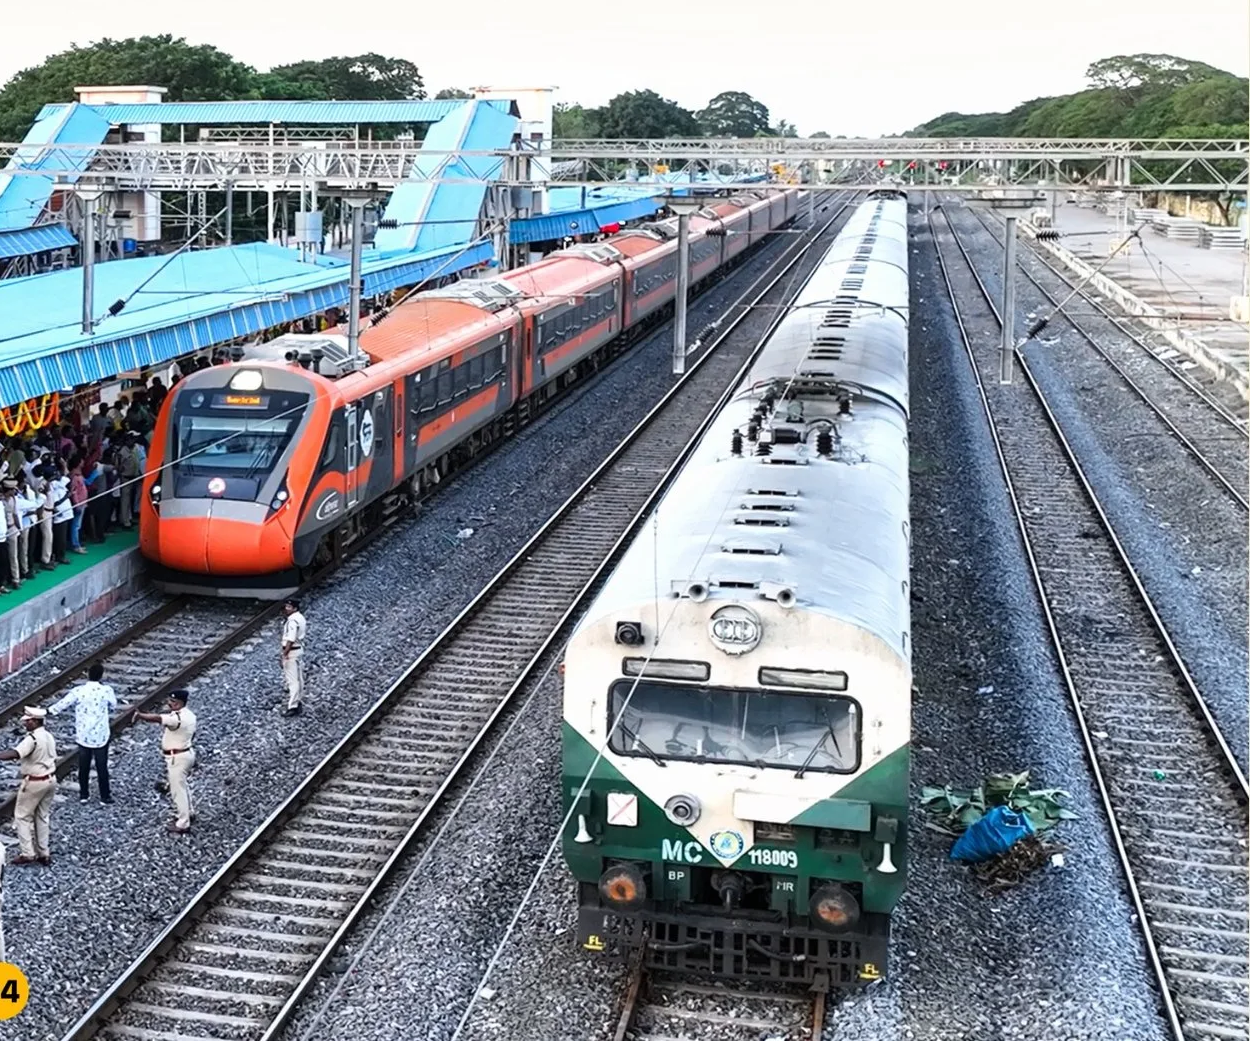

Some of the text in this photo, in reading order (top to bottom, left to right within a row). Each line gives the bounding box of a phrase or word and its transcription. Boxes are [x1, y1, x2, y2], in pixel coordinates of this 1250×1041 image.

[661, 838, 703, 863] MC
[748, 848, 798, 868] 118009
[668, 870, 685, 880] BP
